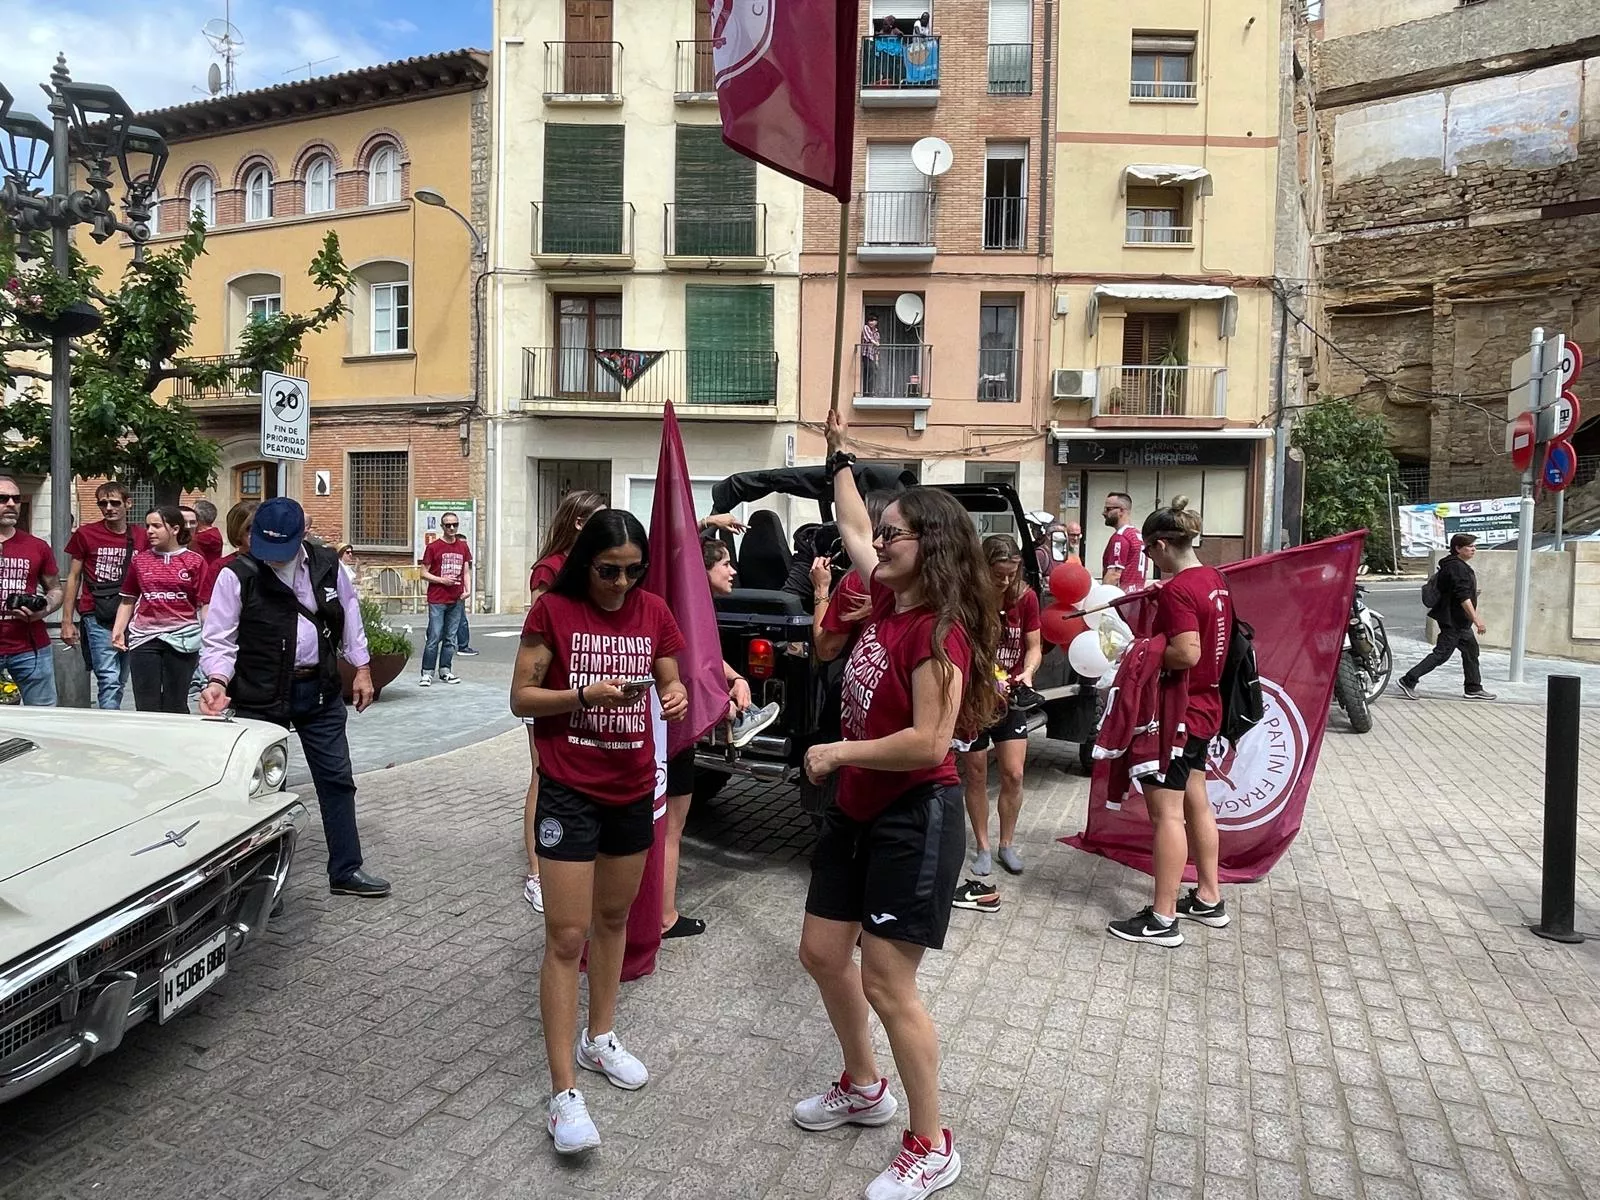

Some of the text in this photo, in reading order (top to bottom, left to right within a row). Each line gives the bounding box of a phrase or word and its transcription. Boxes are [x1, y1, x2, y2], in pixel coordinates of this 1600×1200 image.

[275, 390, 298, 410] 20
[266, 433, 306, 446] PRIORIDAD
[274, 425, 298, 435] FIN DE
[266, 443, 305, 456] PEATONAL
[571, 632, 652, 655] CAMPEONAS
[569, 652, 652, 674] CAMPEONAS
[569, 712, 646, 733] CAMPEONAS
[1212, 717, 1290, 815] PATÍN FRAGA
[164, 979, 174, 1006] H
[176, 958, 205, 997] 5086
